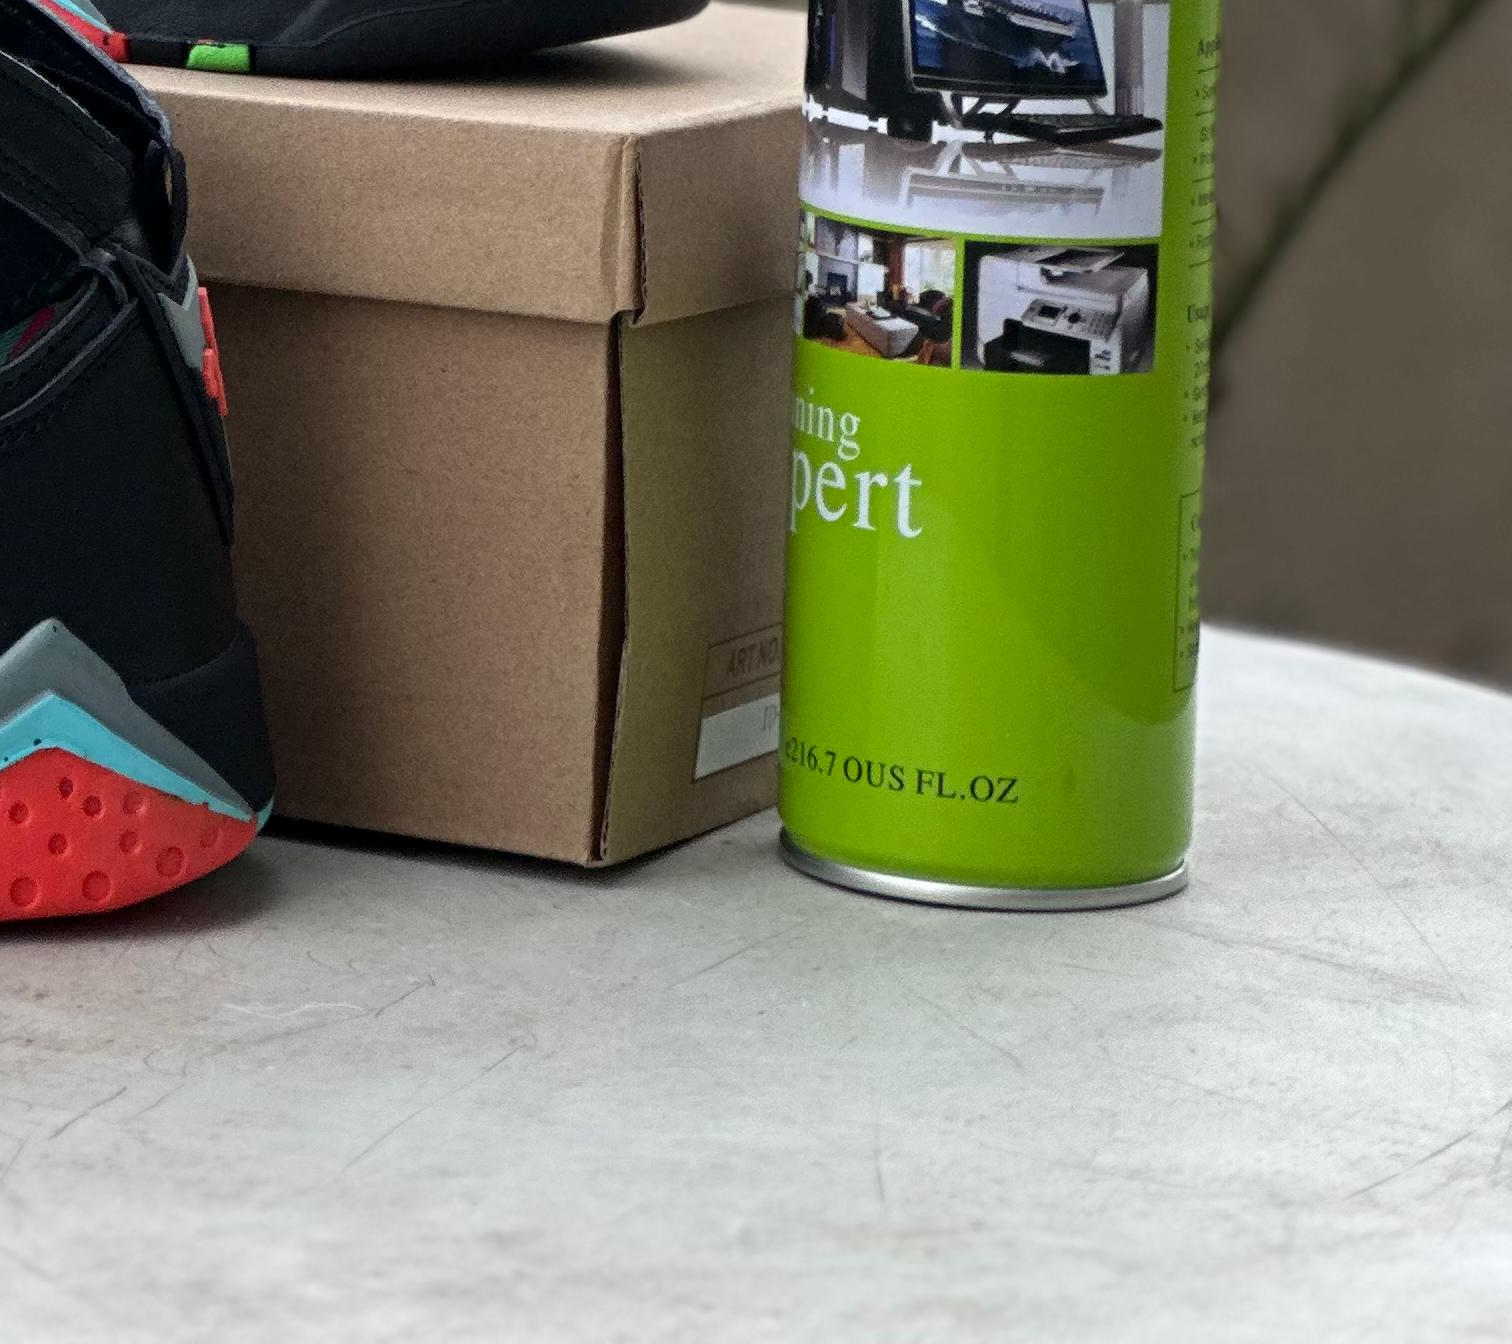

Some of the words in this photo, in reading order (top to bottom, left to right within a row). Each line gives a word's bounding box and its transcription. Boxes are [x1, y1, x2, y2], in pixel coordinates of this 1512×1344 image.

[790, 448, 923, 538] pert
[843, 755, 905, 792] OUS
[916, 768, 1019, 804] FL.OZ
